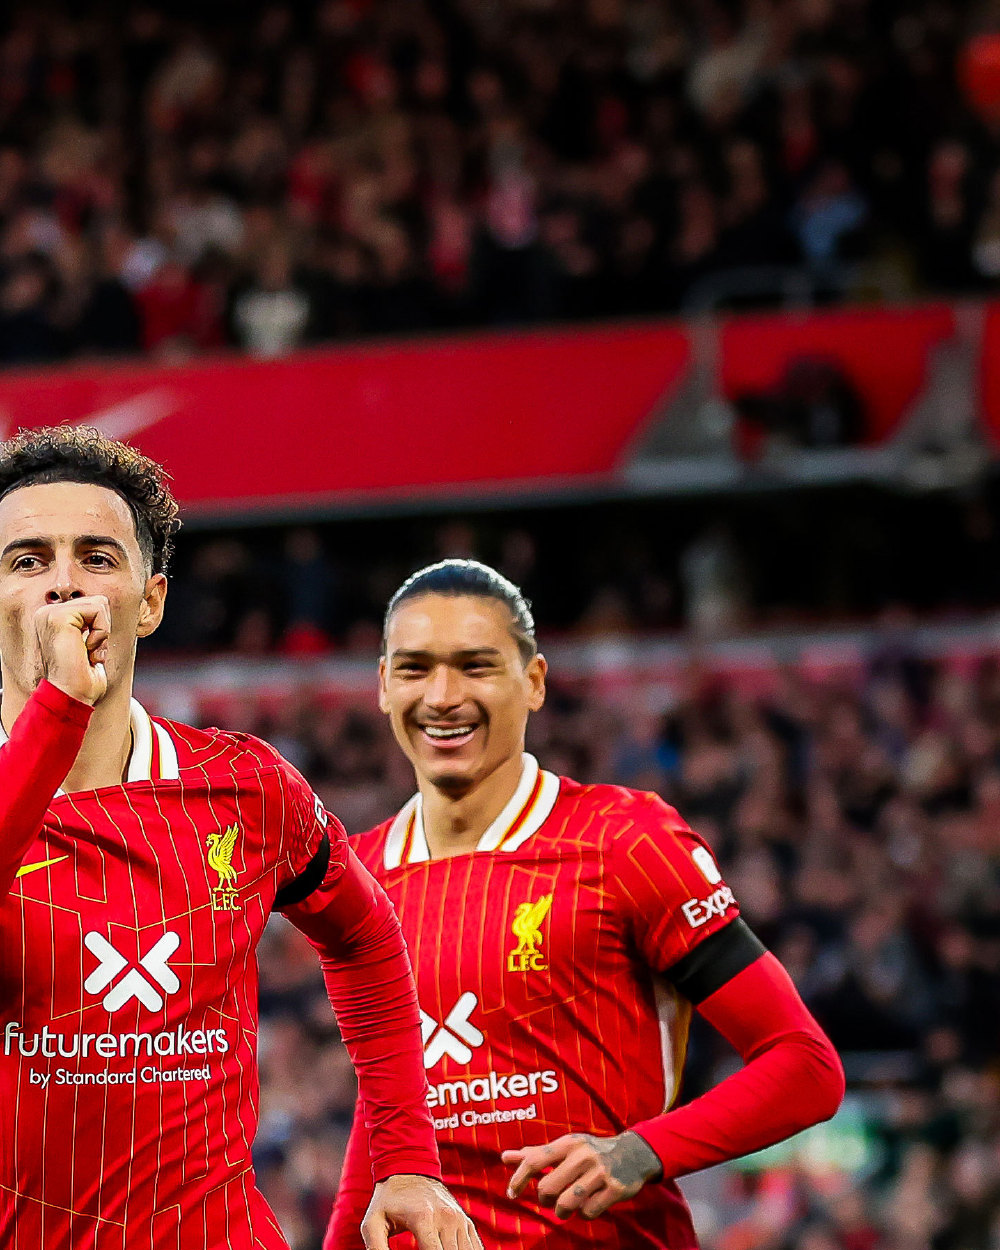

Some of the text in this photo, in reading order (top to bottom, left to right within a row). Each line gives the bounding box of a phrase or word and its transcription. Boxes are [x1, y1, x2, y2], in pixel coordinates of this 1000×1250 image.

[4, 1022, 229, 1058] futuremakers
[29, 1065, 212, 1089] by Standard Chartered
[461, 1104, 536, 1127] Chartered
